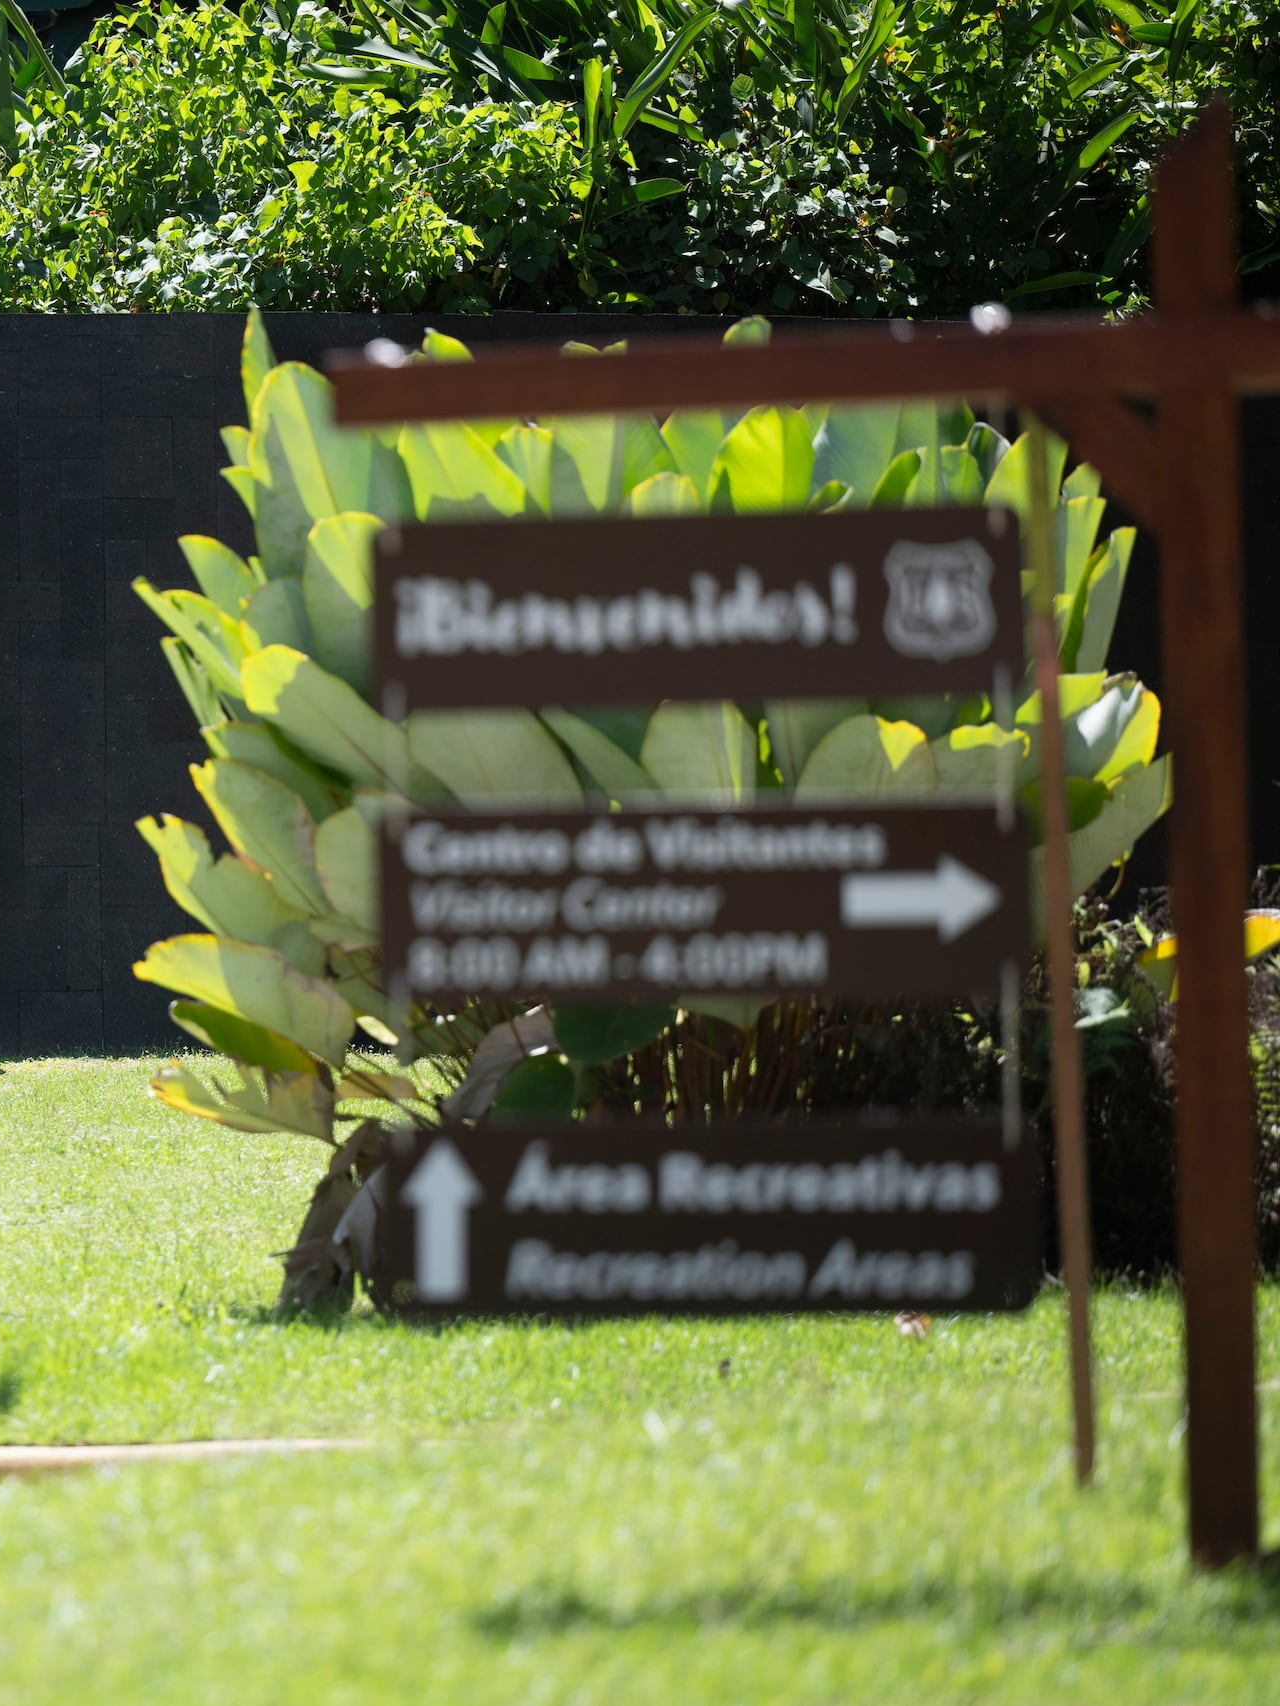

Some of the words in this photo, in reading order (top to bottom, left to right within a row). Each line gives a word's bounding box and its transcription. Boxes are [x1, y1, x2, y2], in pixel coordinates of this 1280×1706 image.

[403, 820, 571, 875] Centro
[574, 817, 644, 874] de
[644, 815, 888, 871] Visitantes
[410, 876, 559, 934] Visitor
[560, 875, 722, 932] Center
[658, 1149, 1000, 1213] Recreativas
[505, 1237, 807, 1300] Recreation
[809, 1237, 976, 1299] Areas
